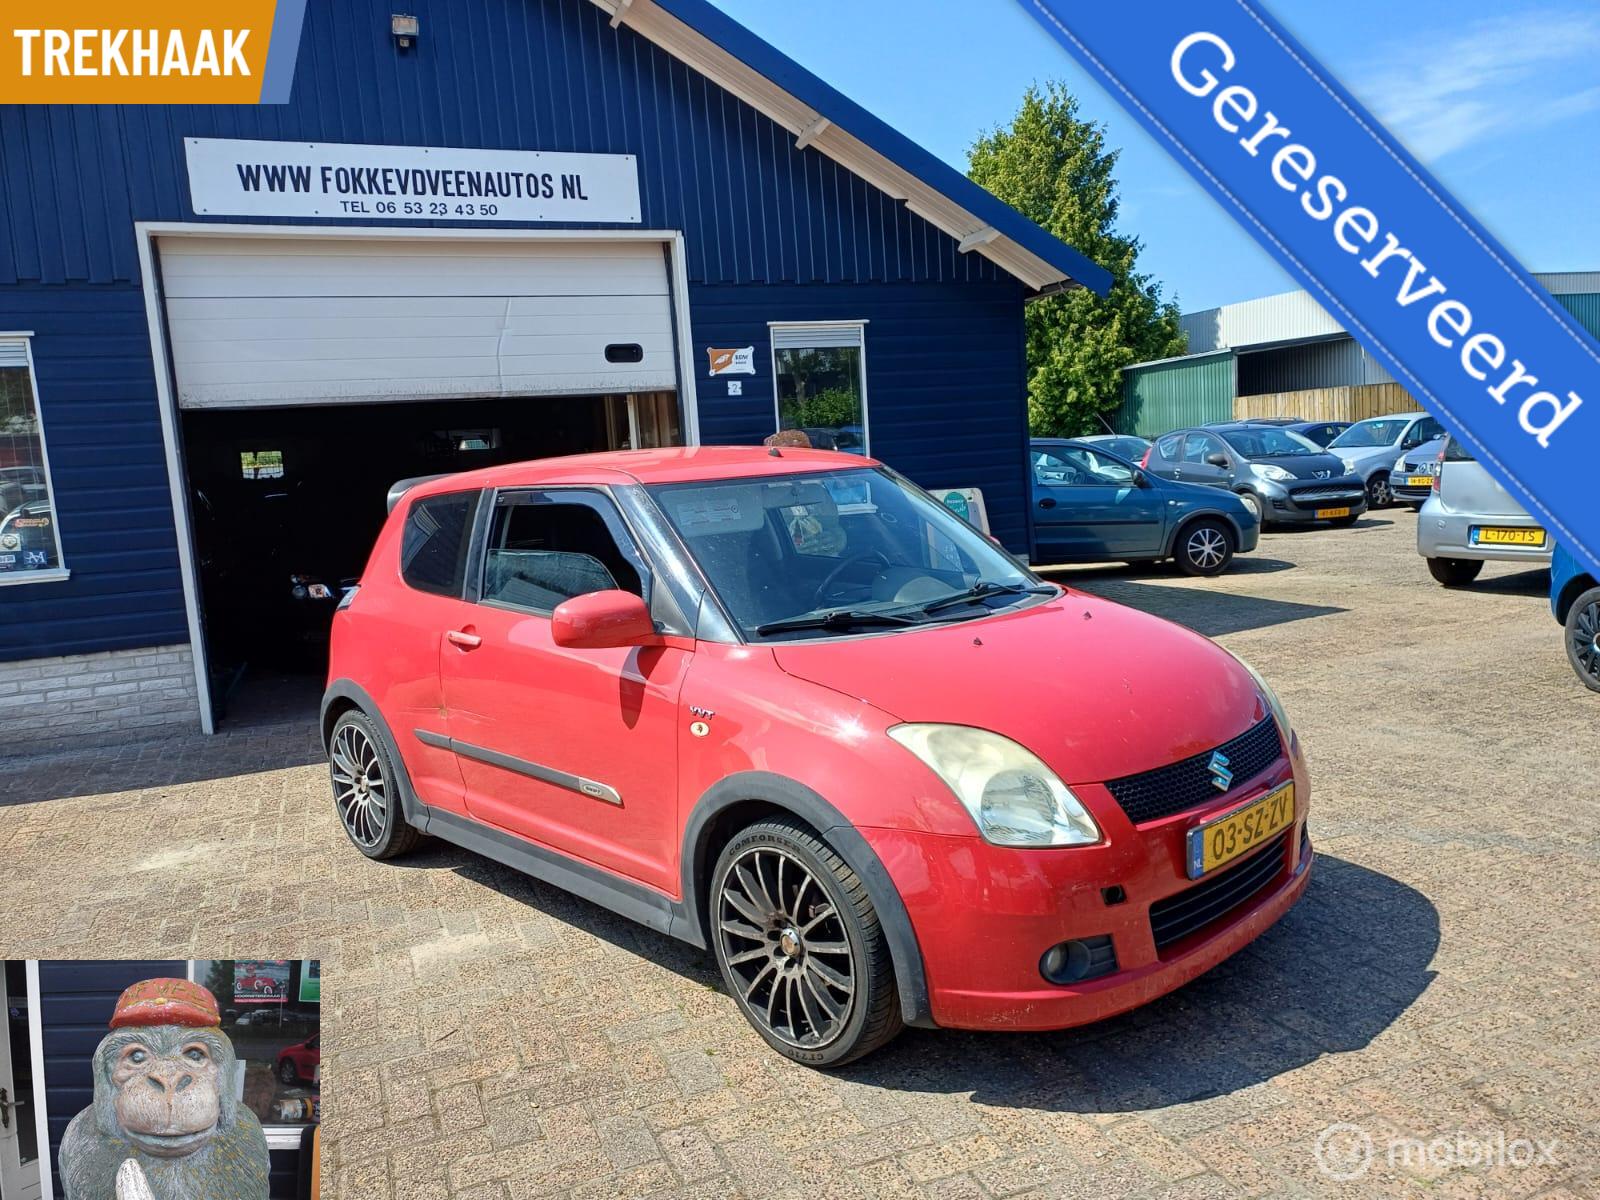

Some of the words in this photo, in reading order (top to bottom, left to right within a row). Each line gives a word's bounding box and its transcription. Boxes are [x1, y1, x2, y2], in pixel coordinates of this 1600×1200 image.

[236, 164, 311, 193] WWW
[320, 166, 554, 199] FOKKEVDVEENAUTOS
[561, 174, 588, 200] NL
[340, 201, 370, 213] TEL
[376, 202, 397, 214] 06
[404, 202, 423, 214] 53
[429, 203, 448, 216] 23
[455, 204, 475, 216] 43
[480, 204, 498, 216] 50
[1485, 528, 1535, 541] L-170-TS
[1212, 792, 1287, 860] 03-SZ-ZV
